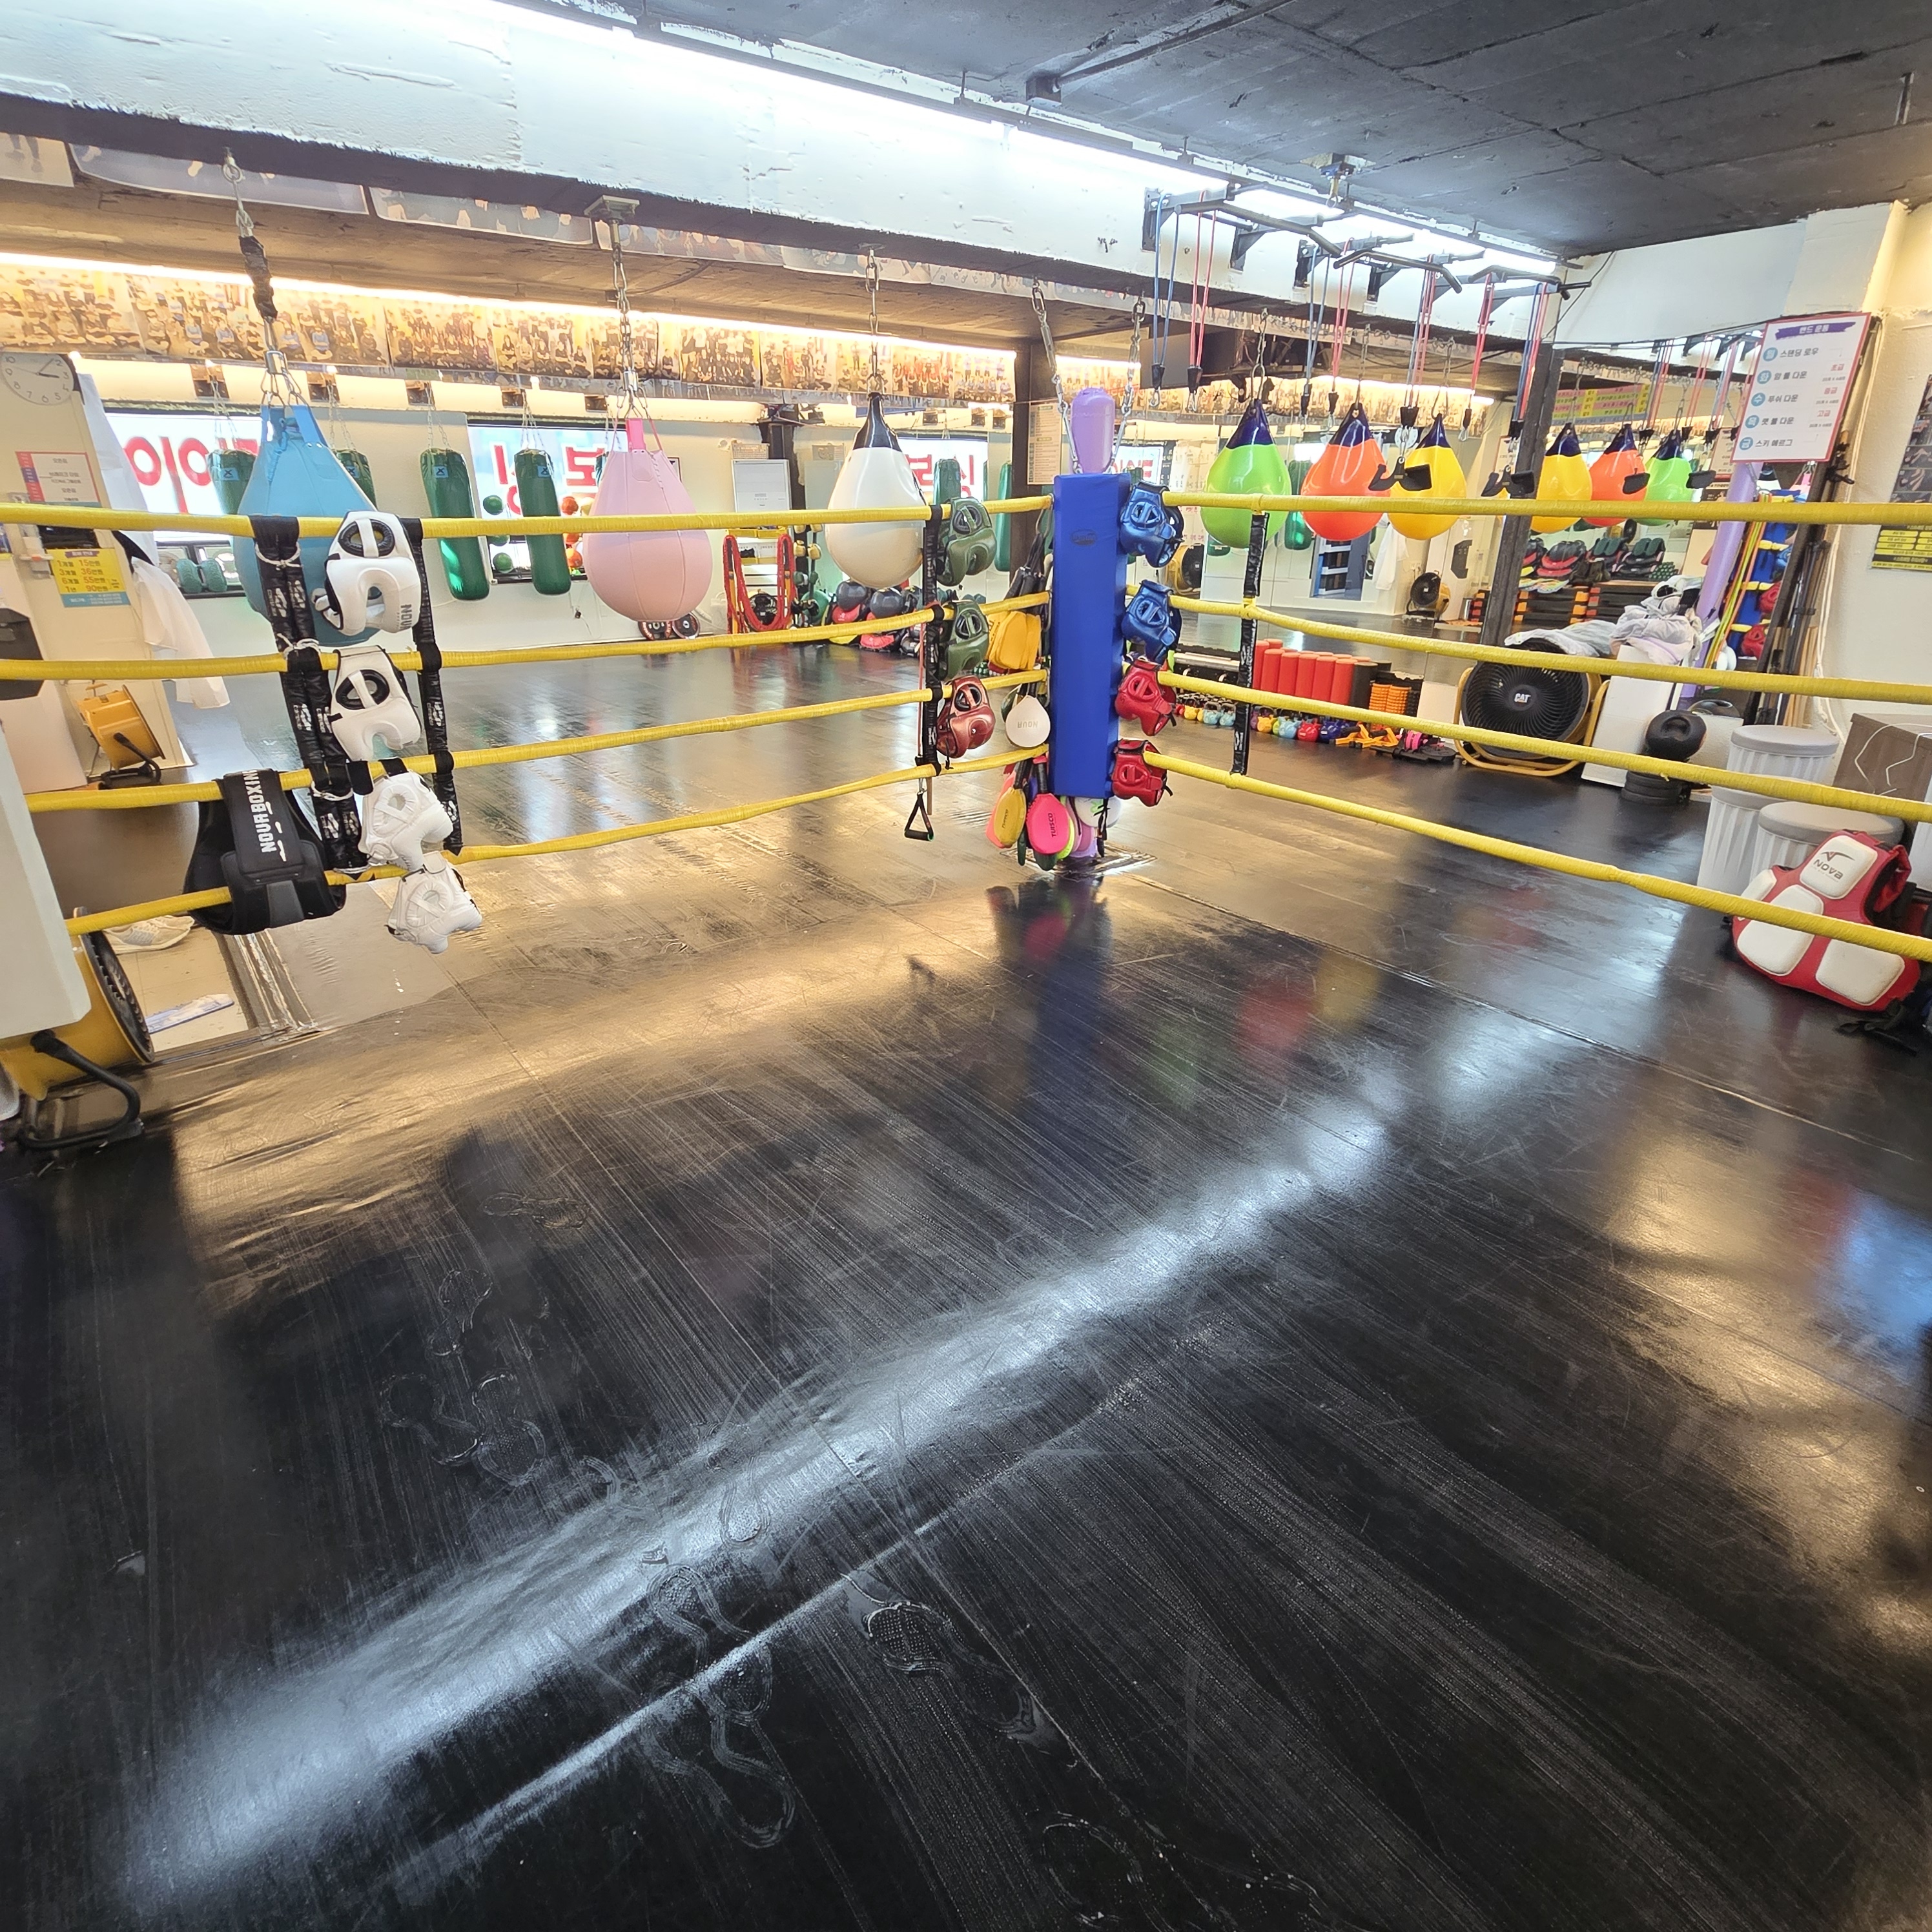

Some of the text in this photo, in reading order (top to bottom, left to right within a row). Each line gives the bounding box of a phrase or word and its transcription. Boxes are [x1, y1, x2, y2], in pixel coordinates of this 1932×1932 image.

[1814, 324, 1829, 333] 운동
[1780, 347, 1819, 358] 스탠딩 로우
[1760, 371, 1769, 382] 화
[1792, 371, 1807, 379] 다운
[1753, 394, 1763, 404] 수
[1768, 395, 1782, 404] 푸쉬
[1780, 416, 1794, 425] 다운
[1742, 438, 1751, 449] 금
[1514, 693, 1531, 703] CAT
[1048, 813, 1056, 838] TUISCO
